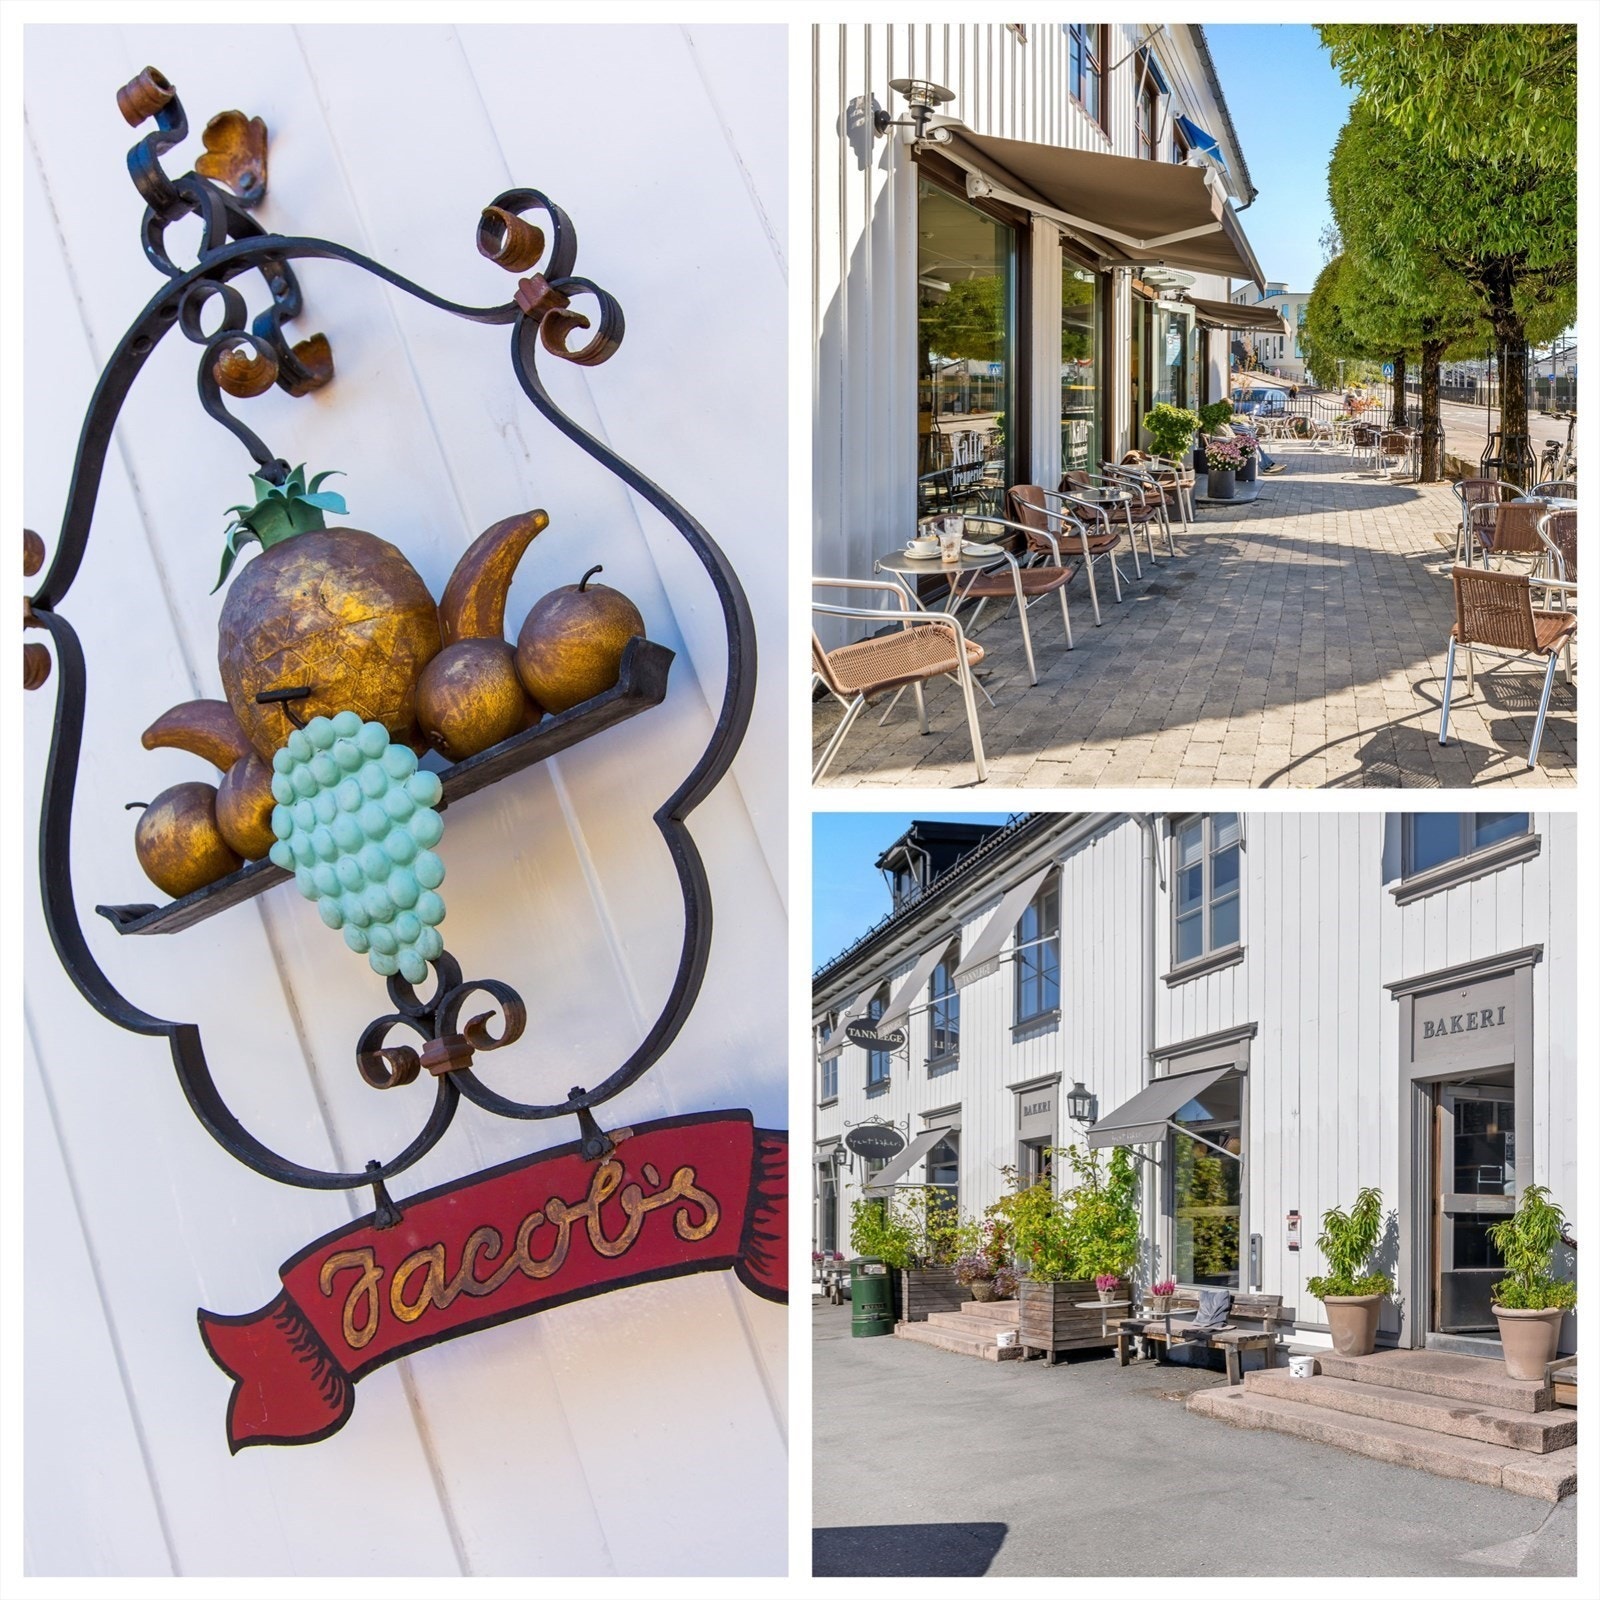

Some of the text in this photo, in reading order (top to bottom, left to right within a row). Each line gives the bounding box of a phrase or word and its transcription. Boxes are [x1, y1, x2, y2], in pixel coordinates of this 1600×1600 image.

[953, 430, 984, 467] Kaffe
[847, 1027, 903, 1043] TANNEGE
[1423, 1005, 1506, 1040] BAKERI
[1023, 1100, 1052, 1117] BAKERI
[319, 1158, 723, 1351] Jacob's
